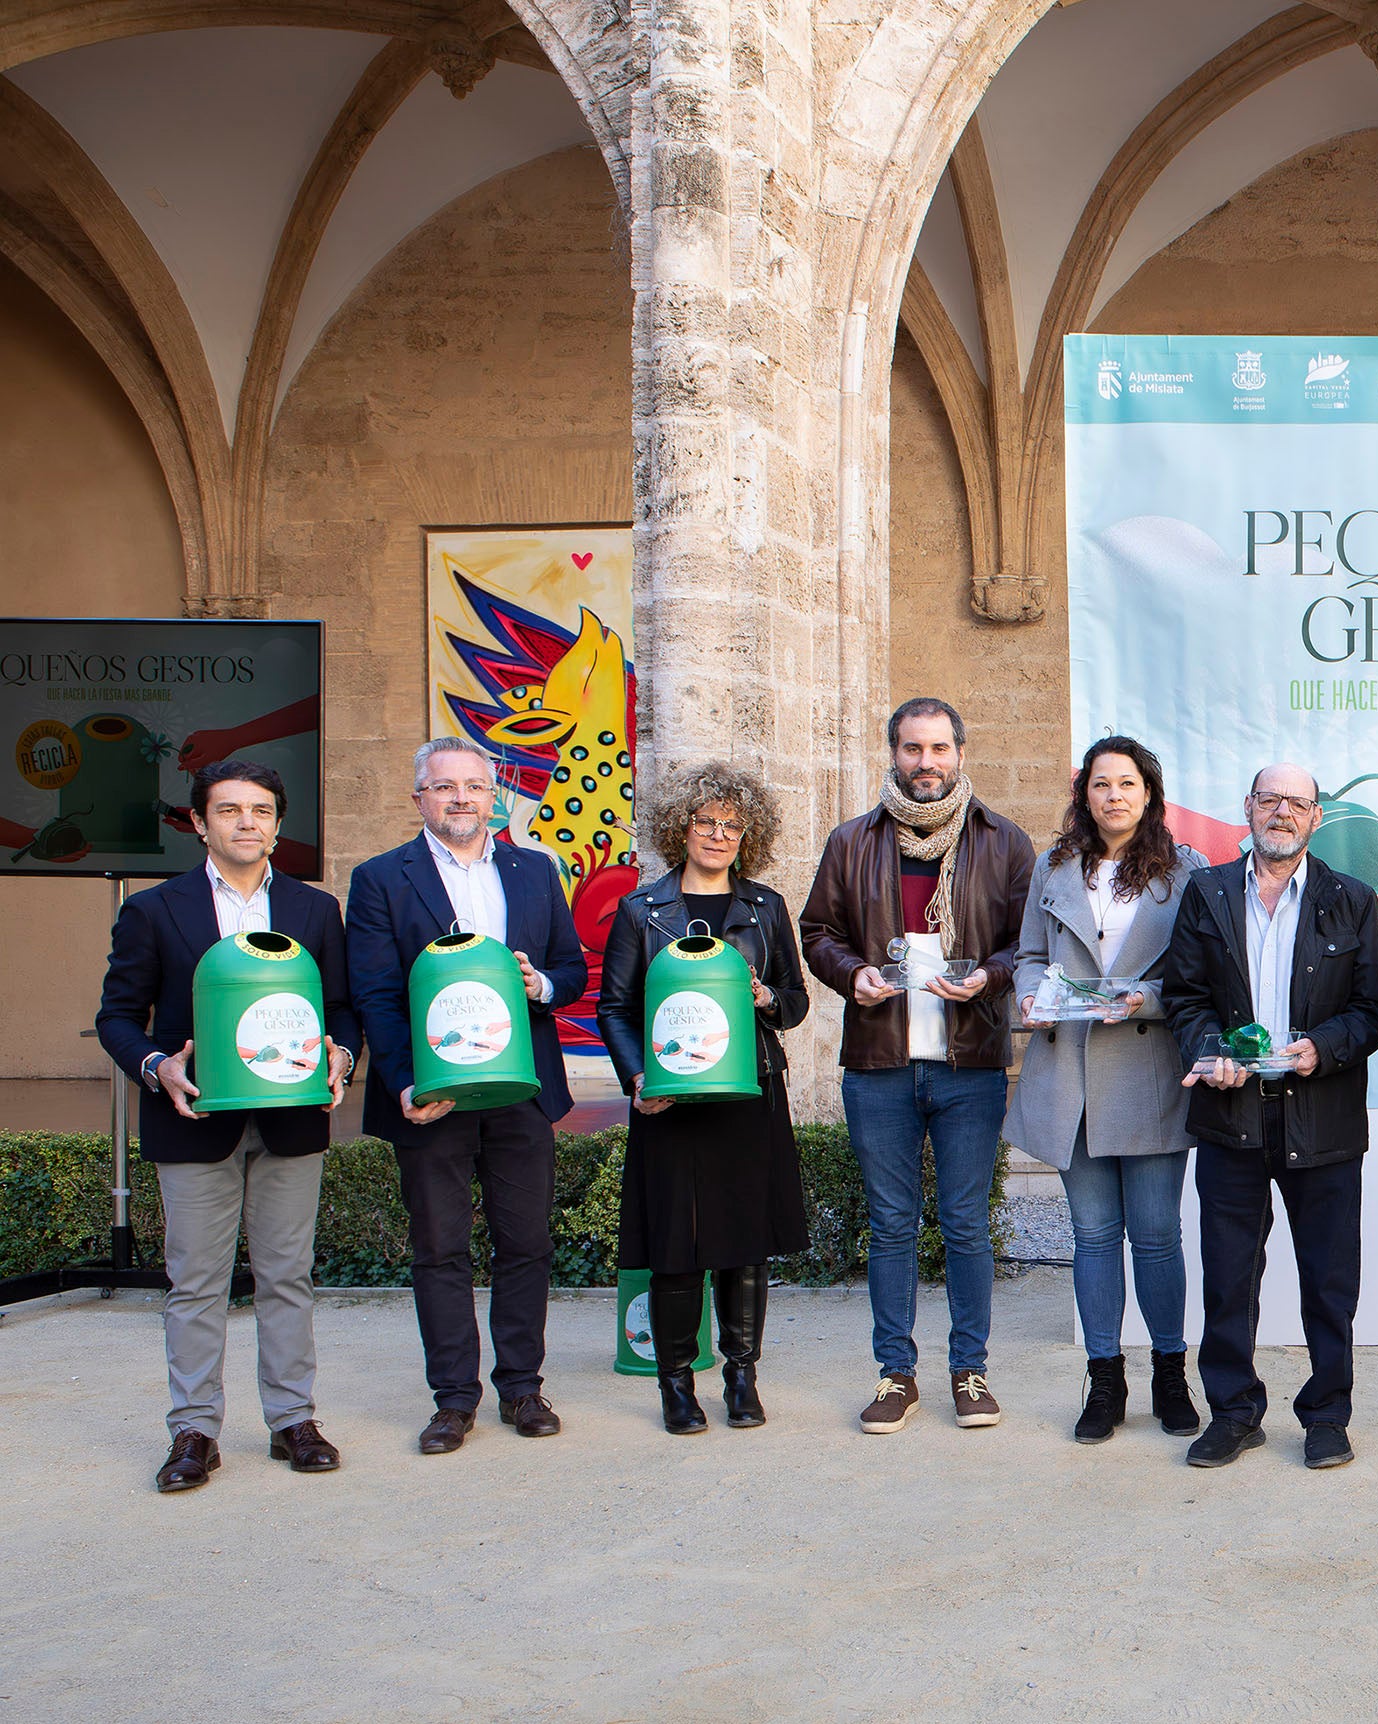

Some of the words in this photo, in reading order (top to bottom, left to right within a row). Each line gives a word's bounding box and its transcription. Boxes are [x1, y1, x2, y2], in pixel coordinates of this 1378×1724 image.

[1128, 371, 1194, 384] Ajuntament
[1128, 383, 1143, 393] de
[1145, 383, 1184, 394] Mislata
[1304, 391, 1350, 399] EUROPEA
[137, 655, 255, 684] GESTOS
[1289, 680, 1325, 711] QUE
[20, 743, 78, 775] RECICLA
[242, 943, 270, 959] SOLO
[668, 1014, 707, 1026] GESTOS
